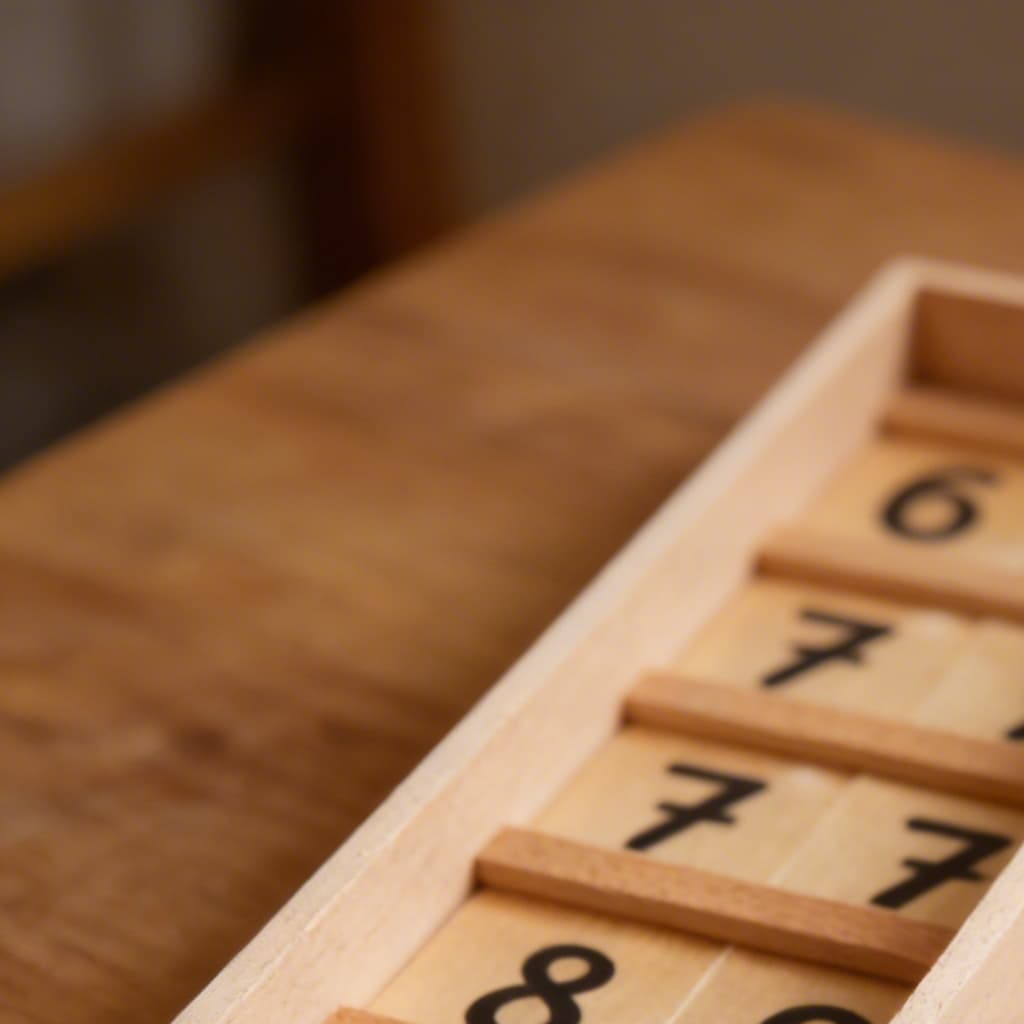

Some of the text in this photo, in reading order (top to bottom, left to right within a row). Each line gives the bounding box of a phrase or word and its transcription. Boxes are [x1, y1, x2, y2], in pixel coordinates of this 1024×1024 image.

[880, 467, 998, 541] 6
[762, 609, 892, 686] 7
[626, 765, 1012, 909] 7 7
